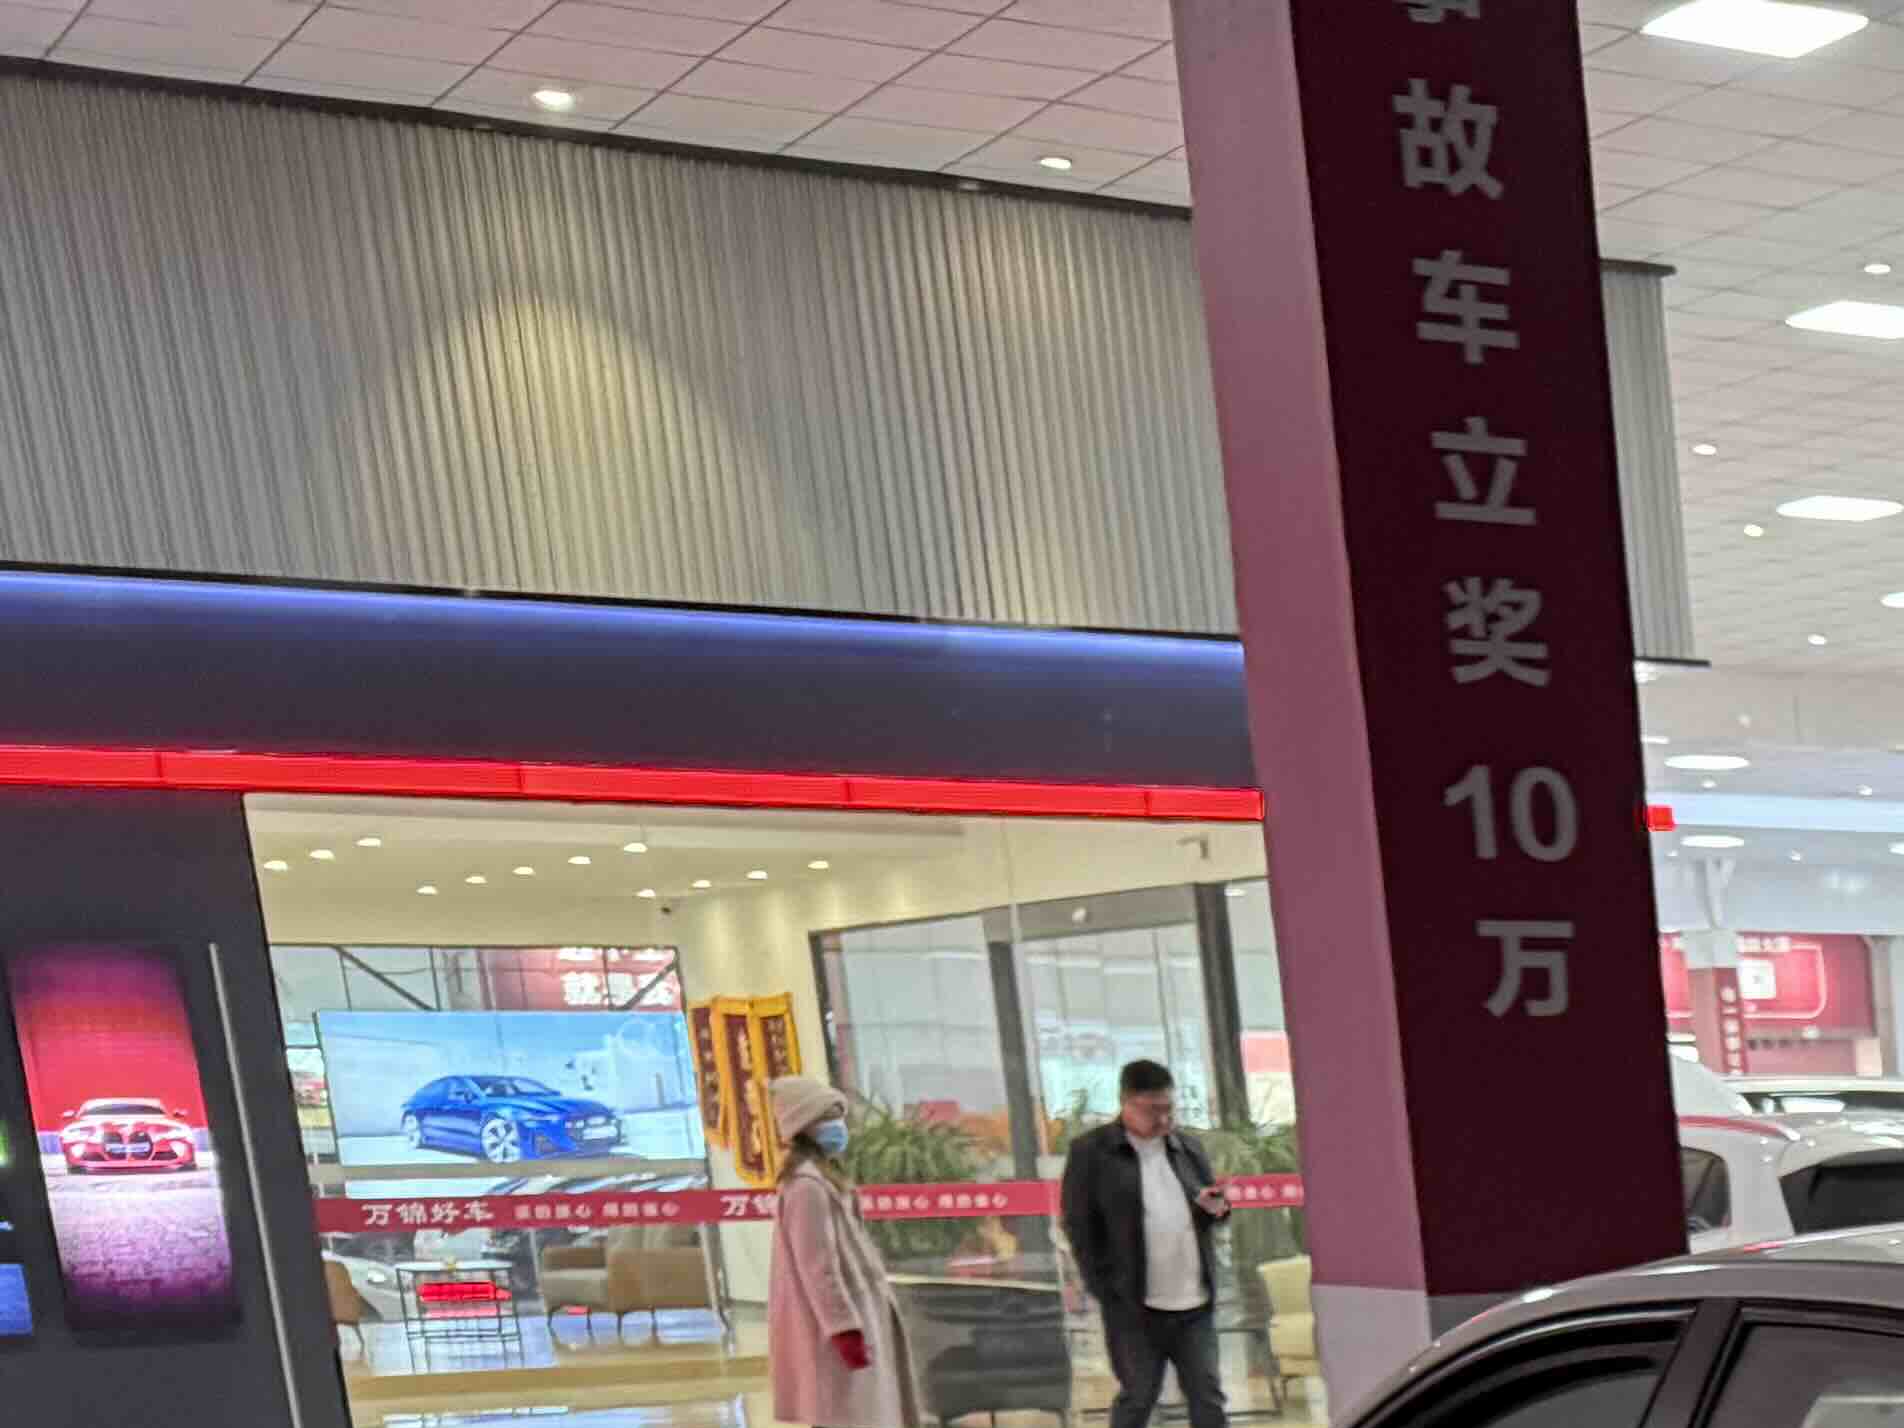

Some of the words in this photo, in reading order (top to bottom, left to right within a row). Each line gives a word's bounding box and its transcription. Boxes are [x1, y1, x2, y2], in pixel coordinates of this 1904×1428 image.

[1391, 0, 1577, 1017] 故车立奖10万
